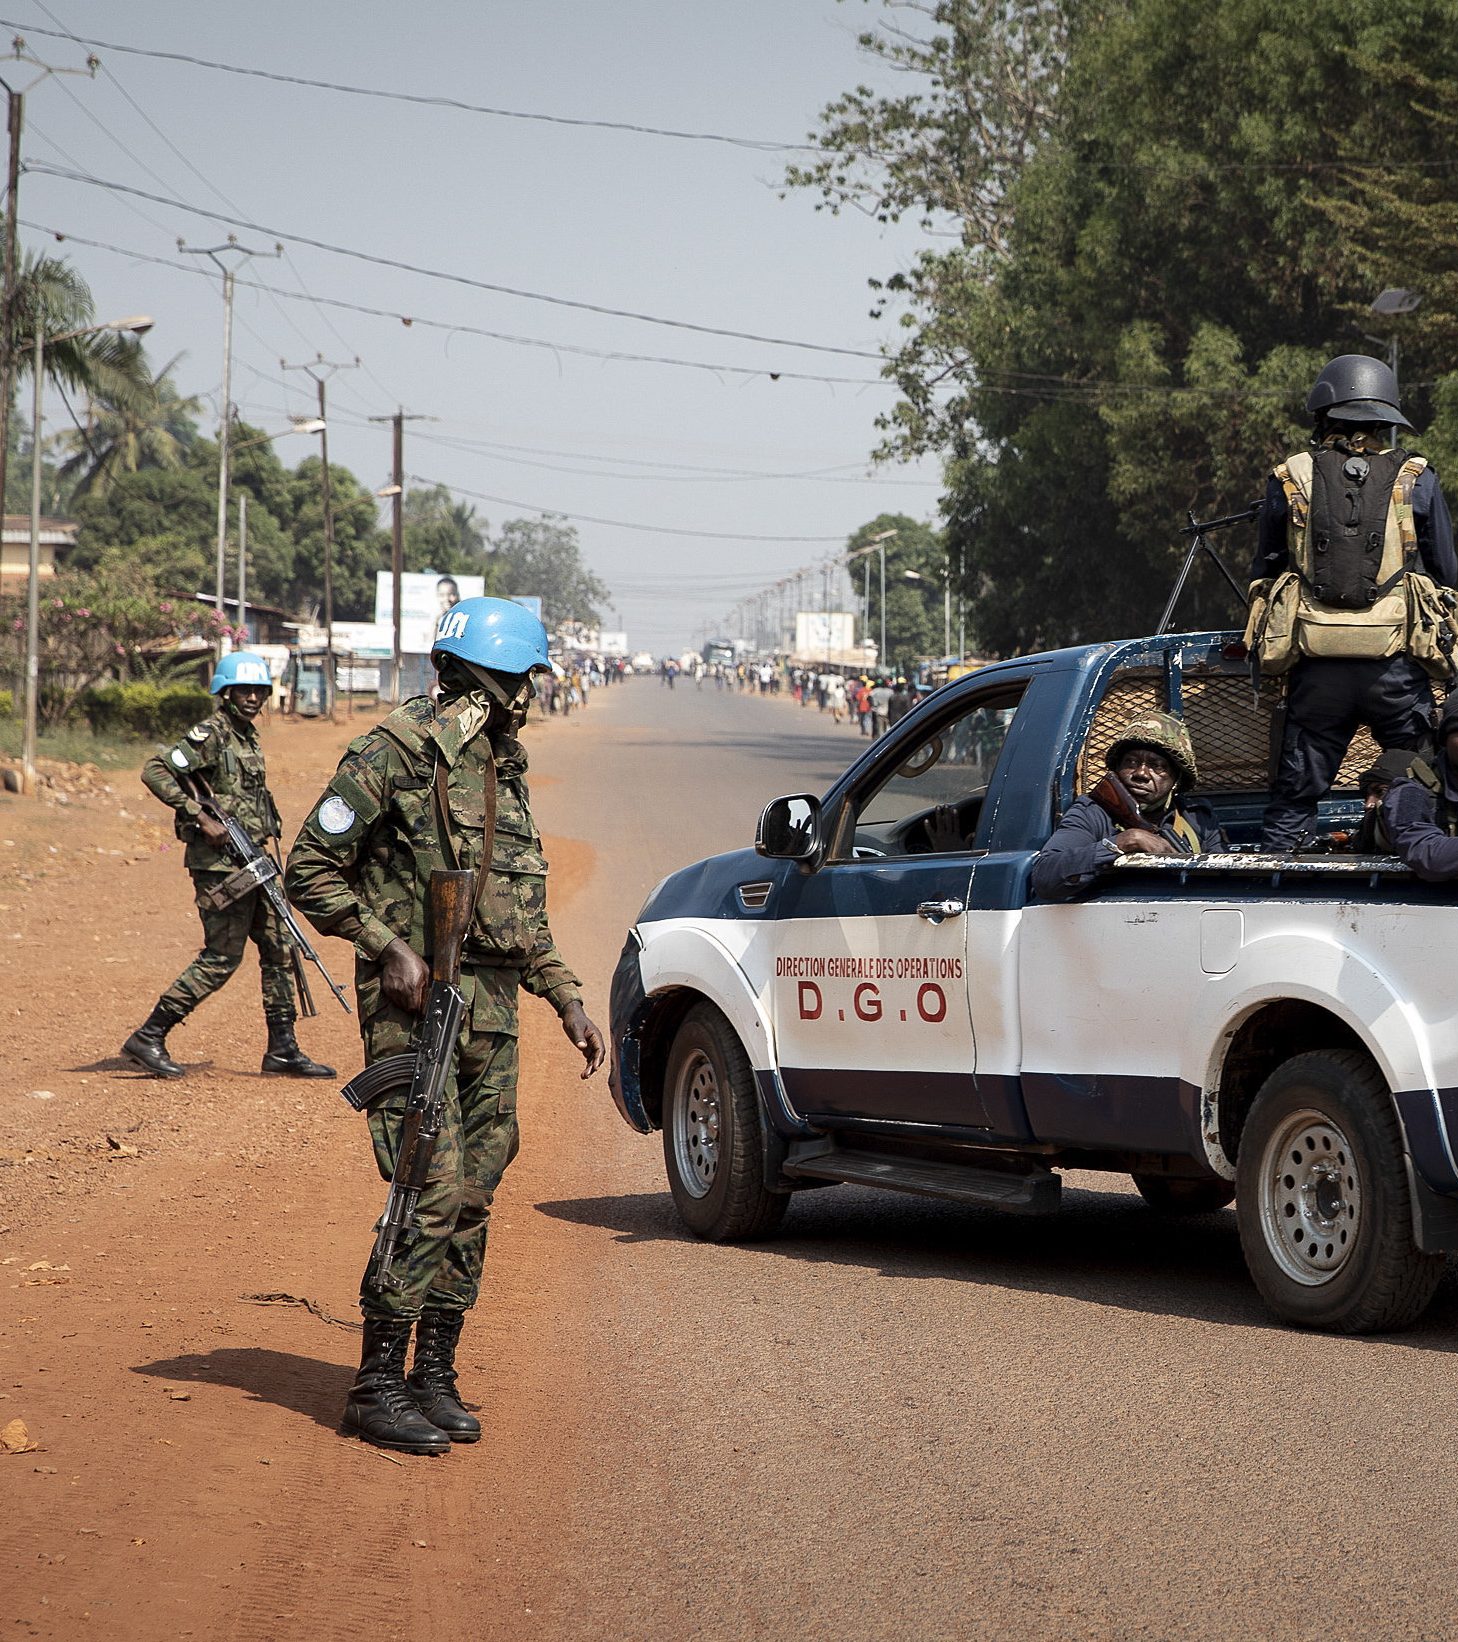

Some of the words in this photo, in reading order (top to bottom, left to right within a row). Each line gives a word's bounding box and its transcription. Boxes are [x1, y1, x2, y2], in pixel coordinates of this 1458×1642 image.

[235, 661, 269, 681] UN
[776, 956, 826, 977] DIRECTION
[827, 957, 874, 979] GENERALE
[876, 957, 894, 979] DES
[896, 957, 963, 979] OPERATIONS
